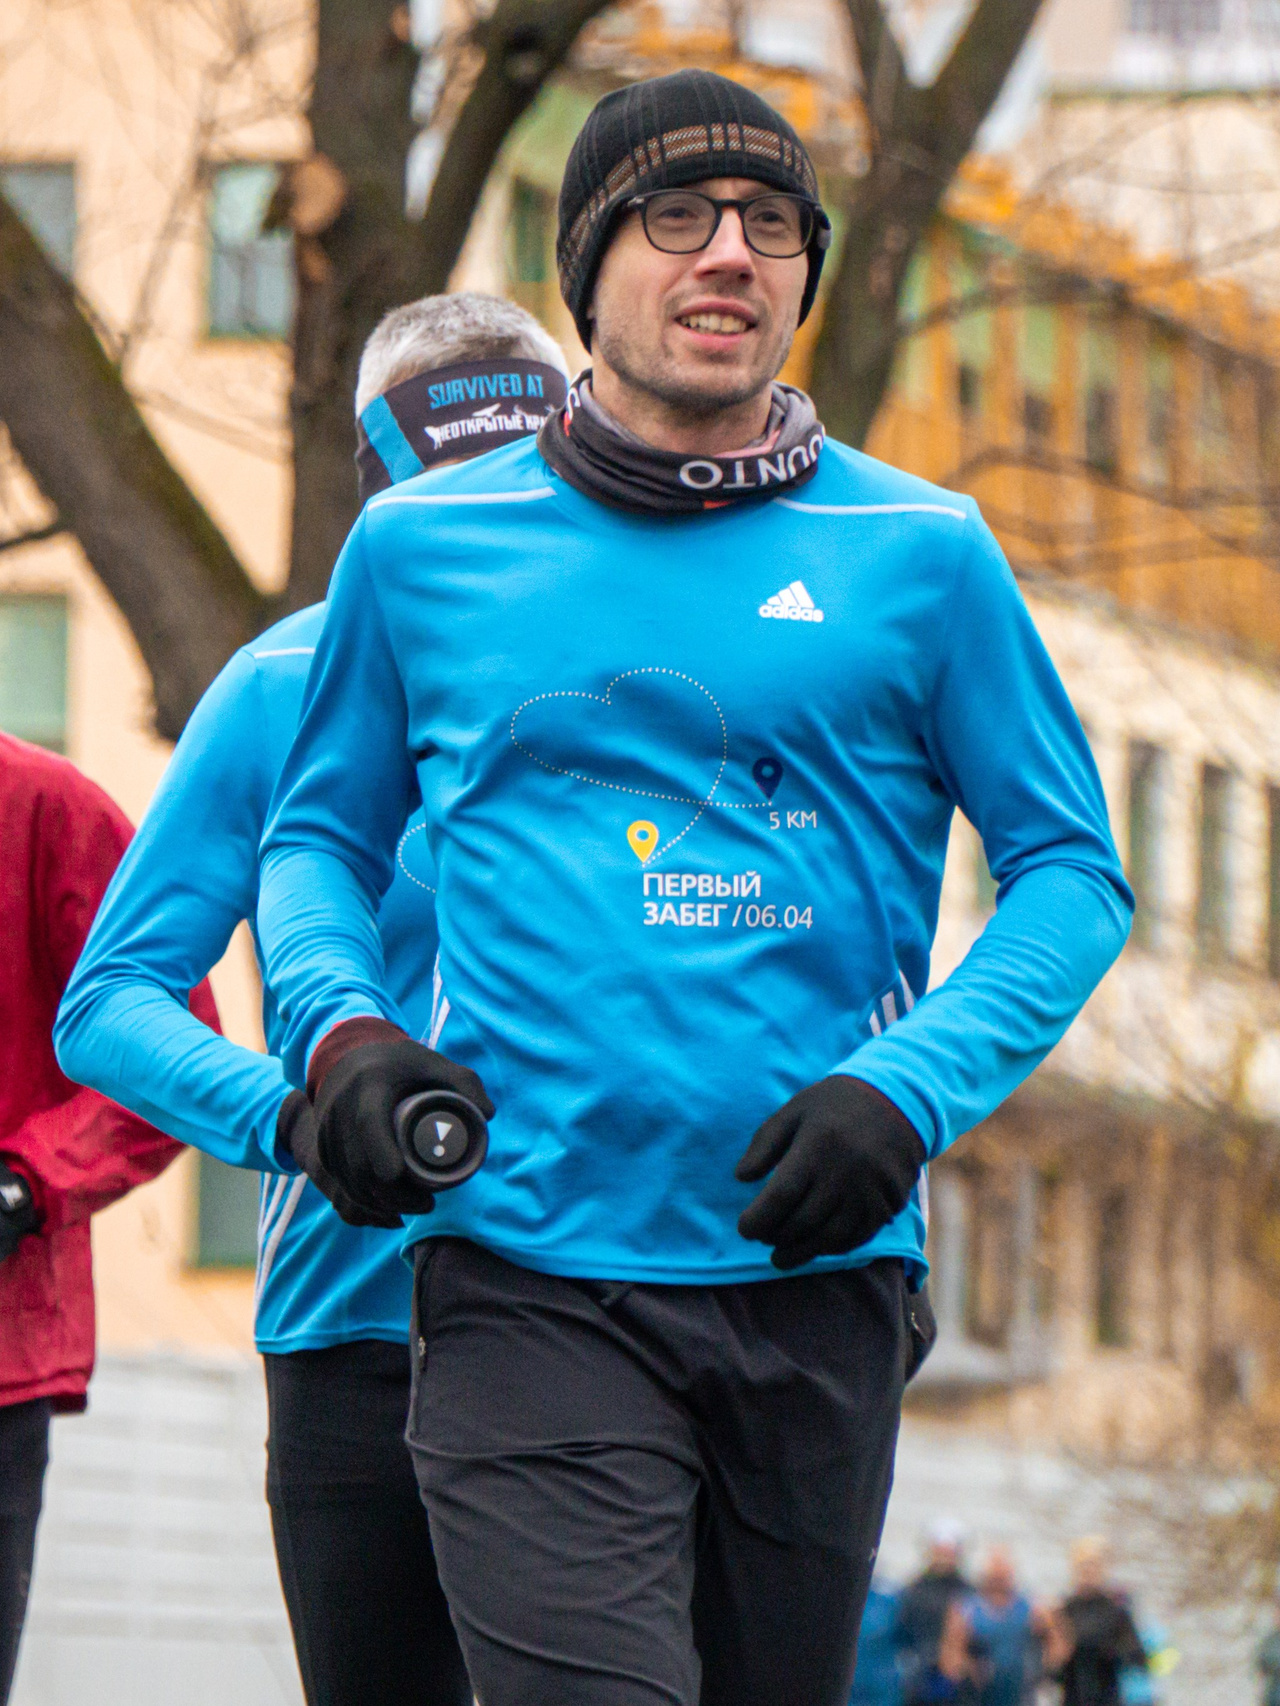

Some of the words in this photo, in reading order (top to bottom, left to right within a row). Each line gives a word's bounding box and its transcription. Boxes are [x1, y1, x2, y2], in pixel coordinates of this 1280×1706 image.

[427, 373, 523, 410] SURVIVED
[526, 373, 544, 398] AT
[759, 604, 824, 622] adidas
[769, 811, 780, 830] 5
[643, 871, 761, 898] ПЕРВЫЙ
[643, 901, 728, 927] ЗАБЕГ
